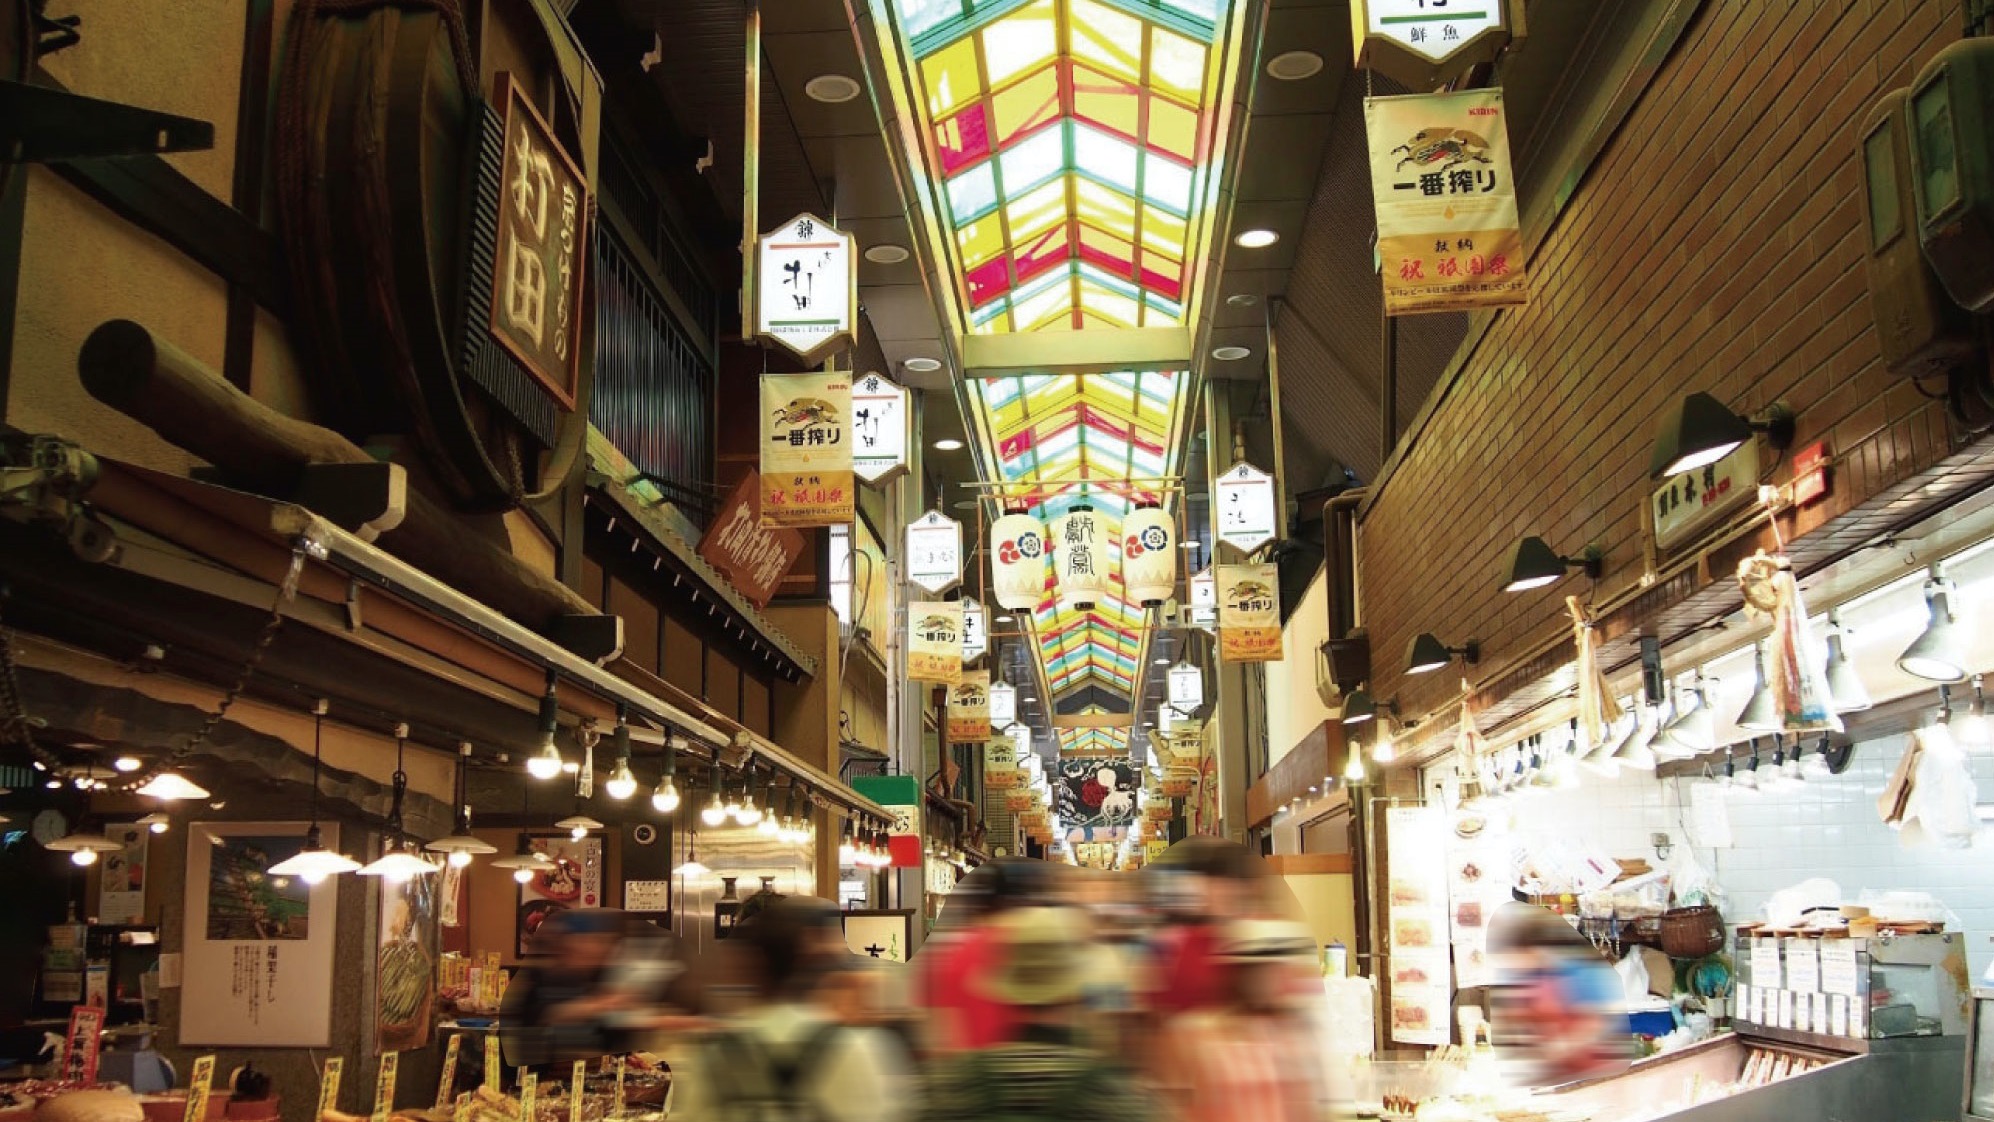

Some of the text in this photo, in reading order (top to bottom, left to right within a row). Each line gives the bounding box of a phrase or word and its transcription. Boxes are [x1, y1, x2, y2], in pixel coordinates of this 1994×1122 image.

[1410, 24, 1459, 42] 鮮魚
[1393, 168, 1496, 195] 一番搾り
[505, 122, 555, 351] 打田
[772, 428, 840, 446] 一番搾り
